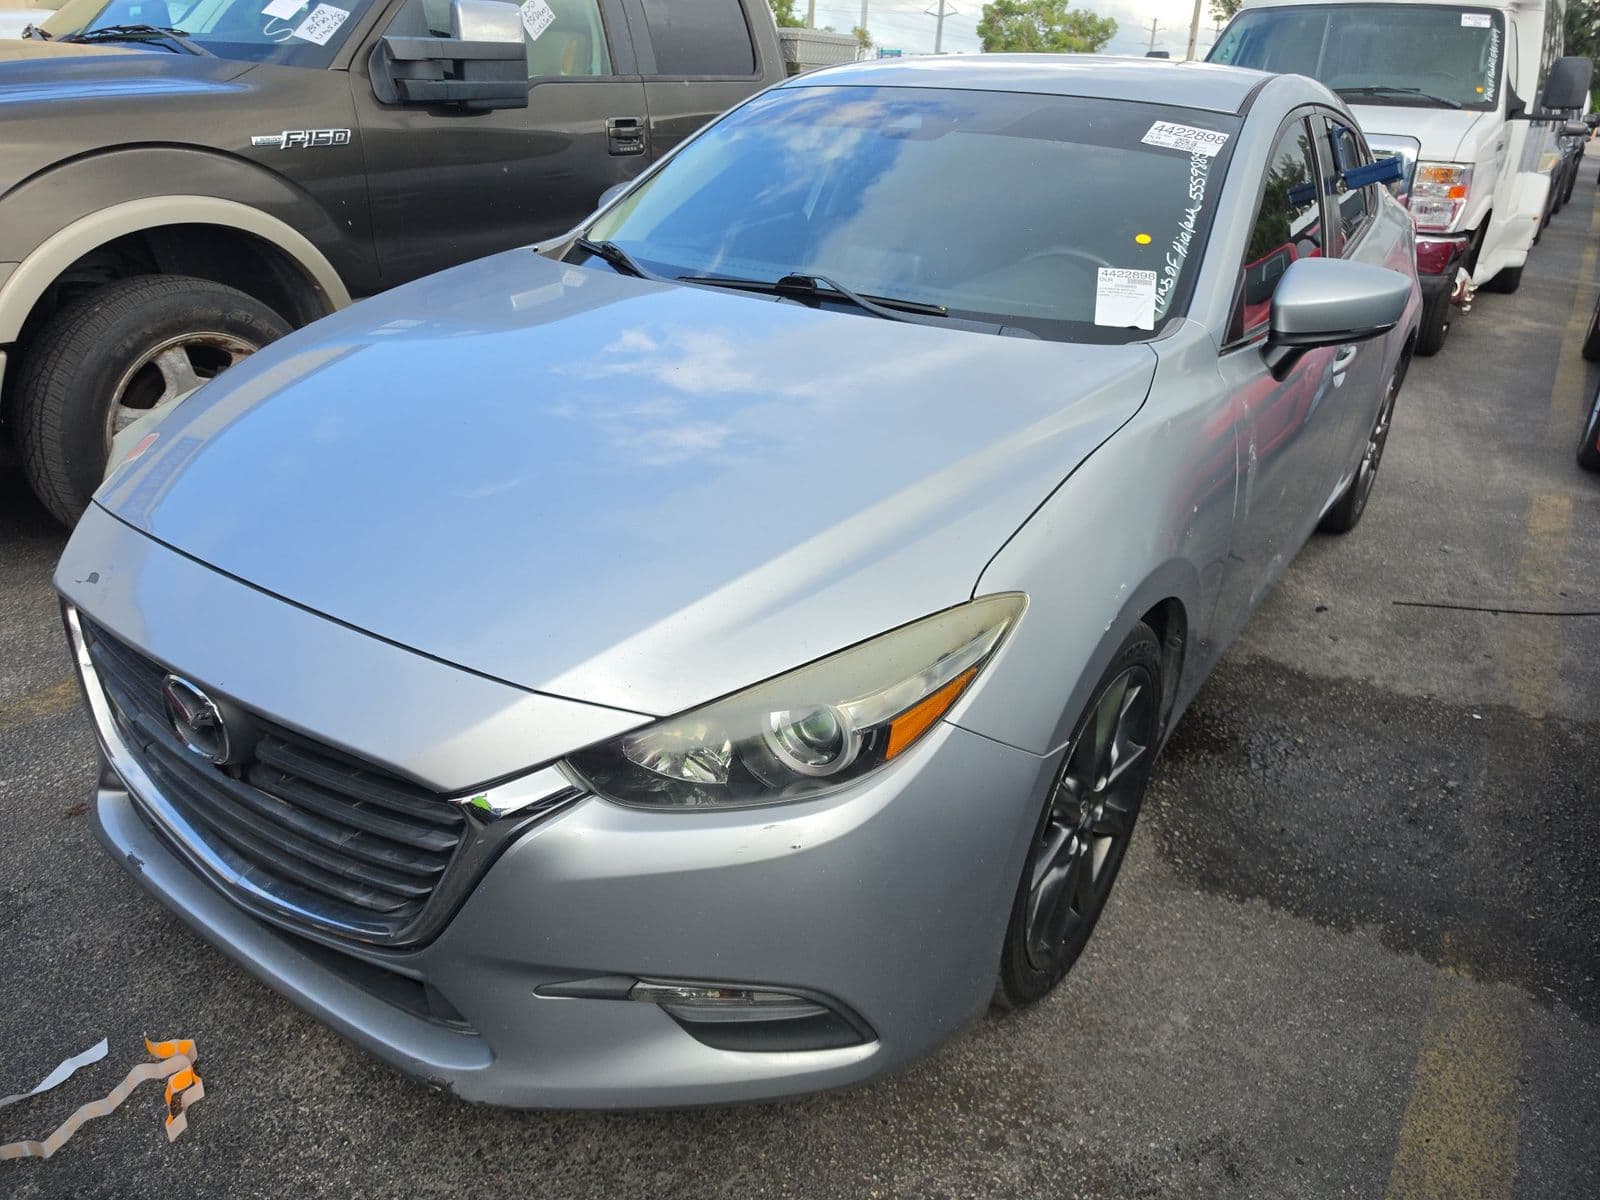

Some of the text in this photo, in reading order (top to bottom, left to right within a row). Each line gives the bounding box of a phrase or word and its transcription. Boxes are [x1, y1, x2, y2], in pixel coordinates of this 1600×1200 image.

[280, 129, 351, 149] F-150
[1154, 124, 1226, 145] 4422898
[1101, 270, 1156, 281] 4422898
